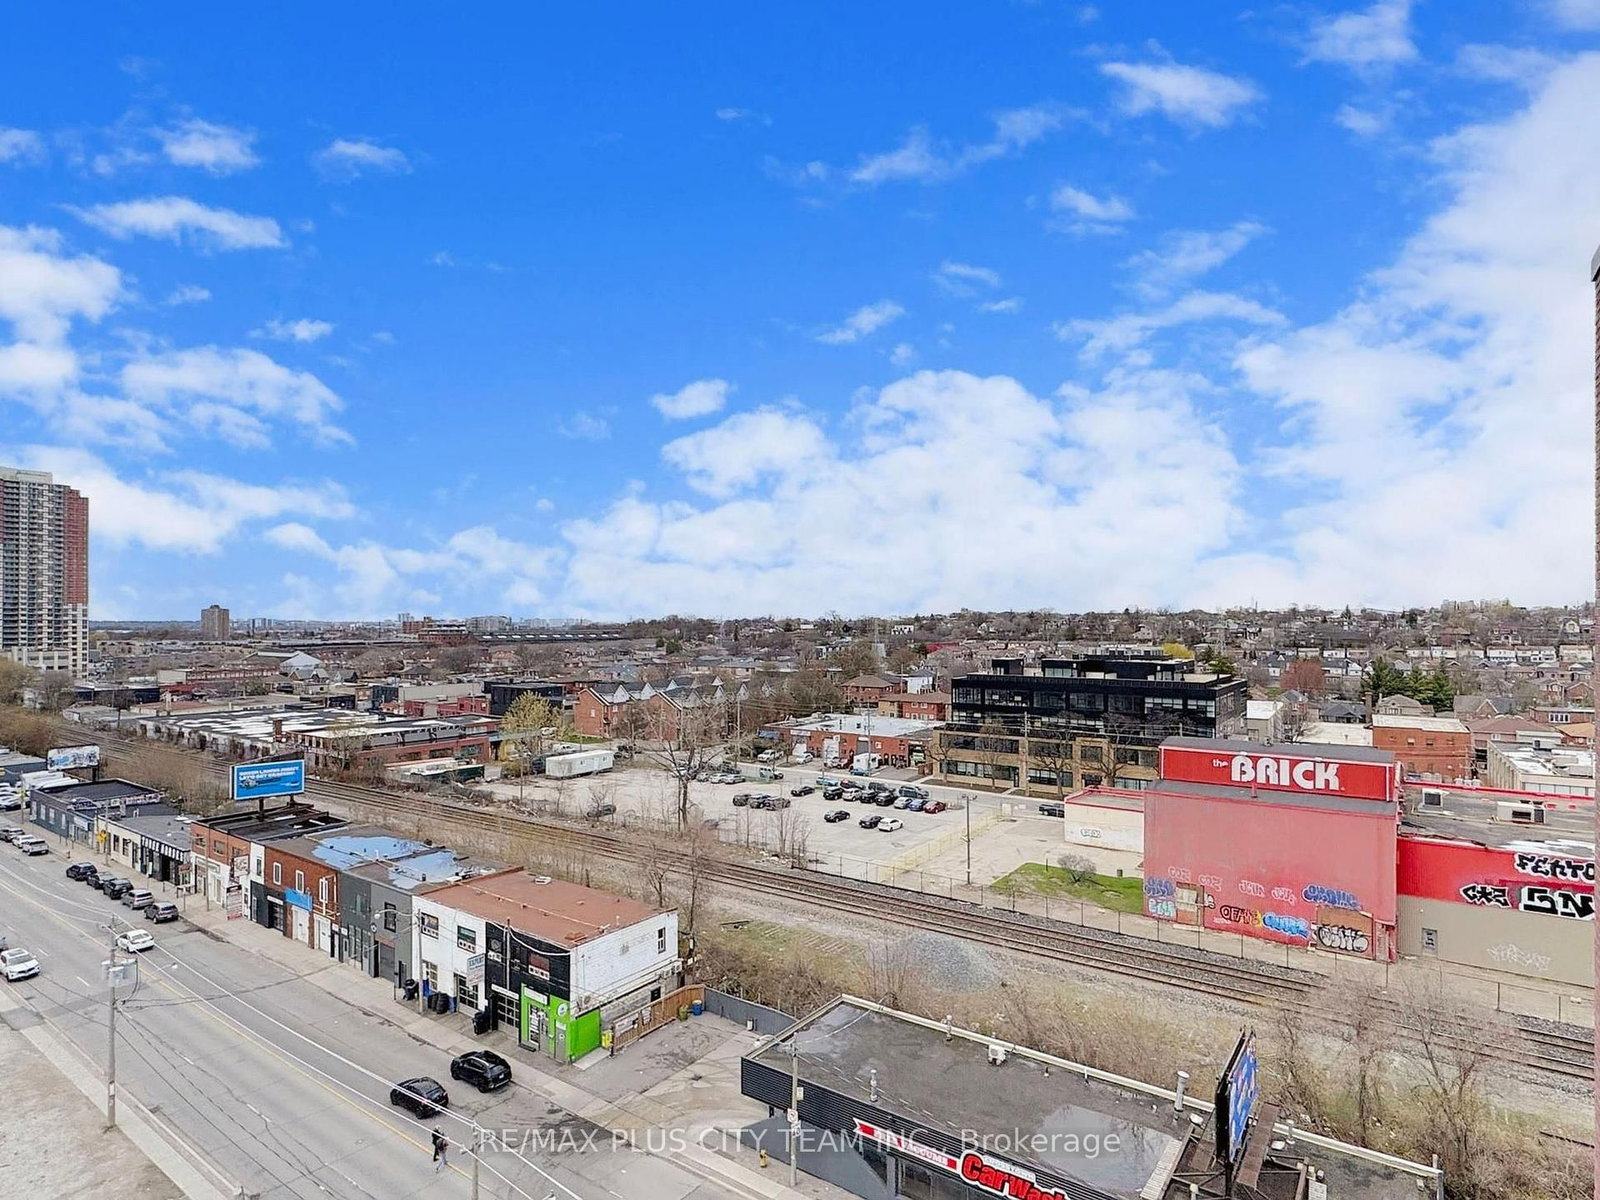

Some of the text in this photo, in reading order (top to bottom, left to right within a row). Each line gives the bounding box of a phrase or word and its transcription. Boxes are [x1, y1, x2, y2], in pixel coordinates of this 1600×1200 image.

[1213, 755, 1340, 791] the BRICK
[962, 1153, 1065, 1200] CarWa
